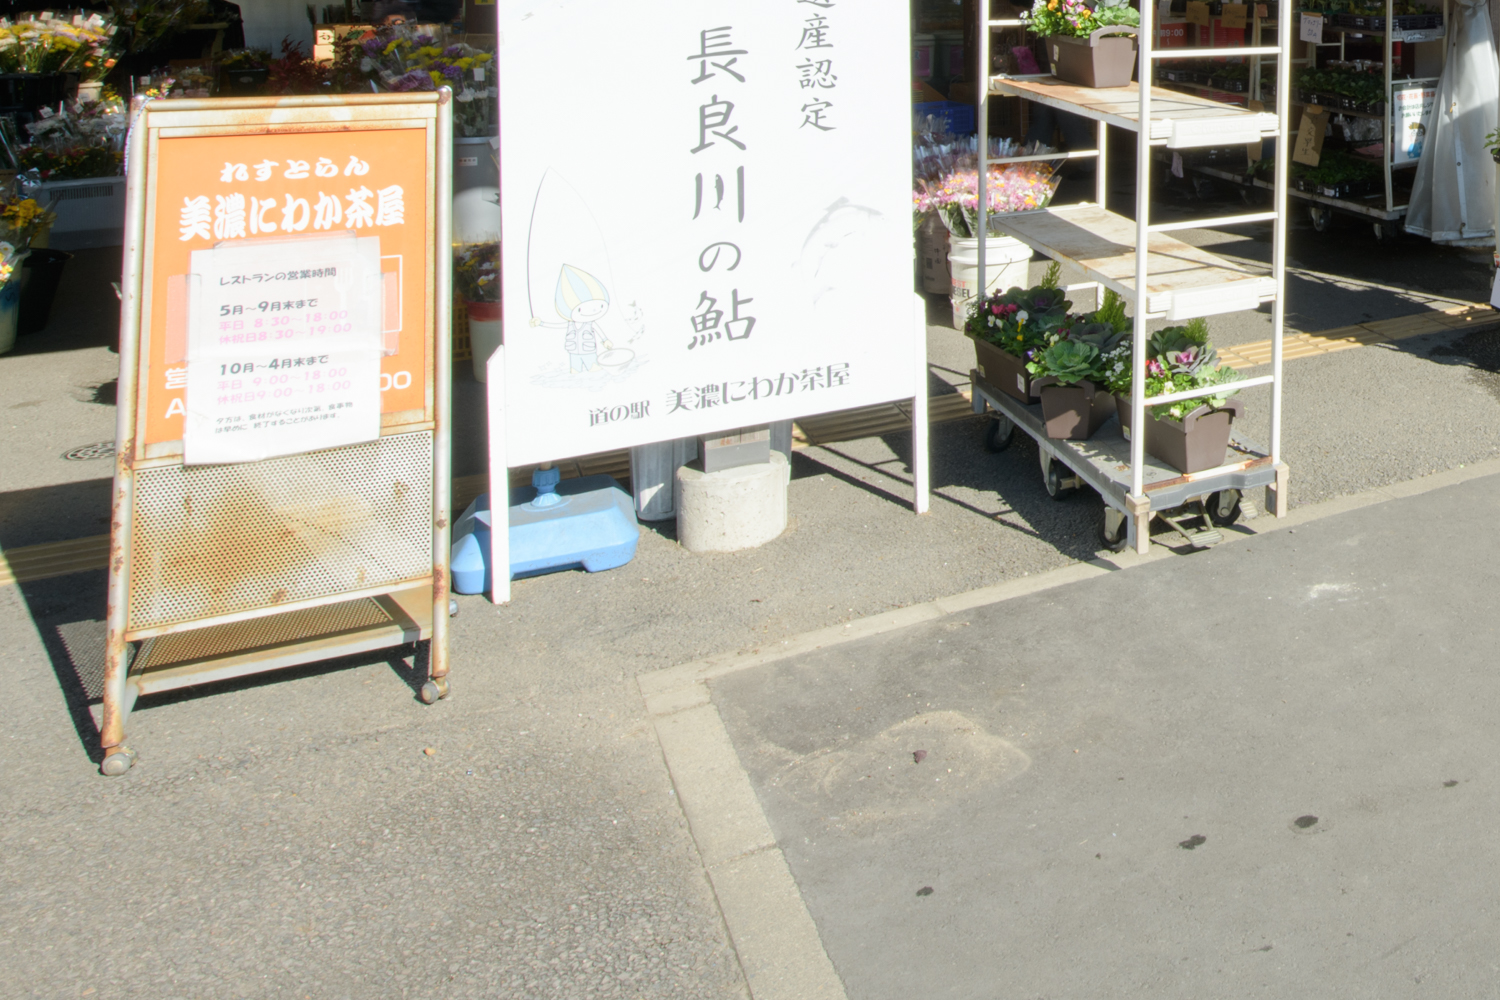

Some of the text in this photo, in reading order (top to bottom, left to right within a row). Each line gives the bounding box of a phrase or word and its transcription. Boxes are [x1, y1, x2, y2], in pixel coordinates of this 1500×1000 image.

[220, 156, 370, 183] れすとらん
[179, 185, 406, 241] 美濃にわか茶屋
[219, 267, 337, 286] レストランの営業時間
[219, 320, 244, 331] 平日
[217, 379, 242, 391] 平日
[588, 362, 850, 428] 道の駅 美濃にわか茶屋
